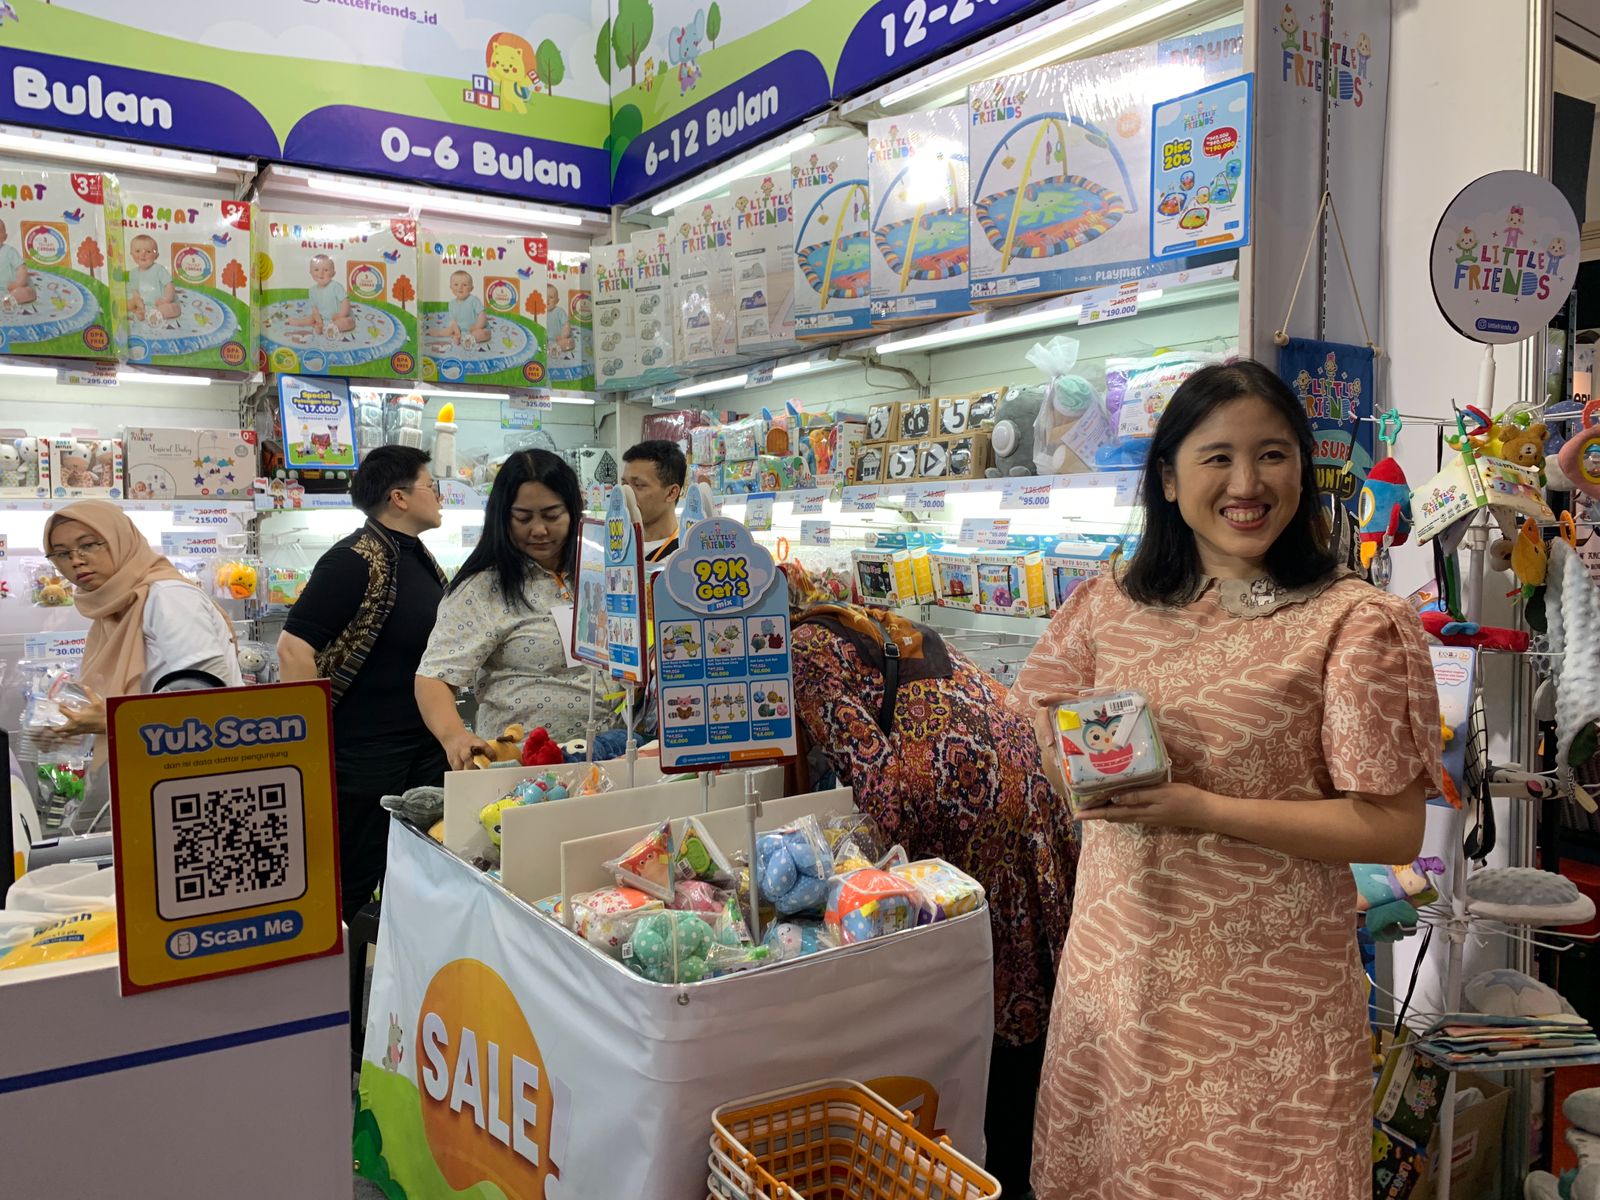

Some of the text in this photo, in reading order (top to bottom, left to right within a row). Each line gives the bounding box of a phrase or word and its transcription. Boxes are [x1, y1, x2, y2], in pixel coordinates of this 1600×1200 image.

[881, 0, 999, 57] 12-2
[1302, 30, 1358, 70] LITTLE
[1282, 50, 1364, 107] FRIENDS
[12, 65, 173, 130] Bulan
[972, 105, 1022, 126] FRIENDS
[645, 84, 779, 176] 6-12 Bulan
[380, 126, 581, 190] 0-6 Bulan
[869, 145, 915, 163] FRIENDS
[1164, 139, 1192, 156] Disc
[1163, 154, 1192, 170] 20%
[792, 174, 834, 189] FRIENDS
[750, 194, 789, 210] LITTLE
[692, 219, 728, 236] LITTLE
[737, 206, 793, 230] FRIENDS
[301, 240, 344, 251] ALL-IN-1
[1480, 243, 1546, 270] LITTLE
[1453, 264, 1550, 300] FRIENDS
[701, 540, 736, 550] FRIENDS
[694, 556, 749, 583] 99K
[697, 580, 750, 600] Get 3
[716, 600, 733, 609] mix
[143, 717, 303, 752] Yuk Scan
[164, 761, 182, 770] dan
[183, 760, 191, 768] isi
[192, 757, 212, 767] data
[241, 750, 289, 764] pengunjung
[201, 917, 294, 949] Scan Me
